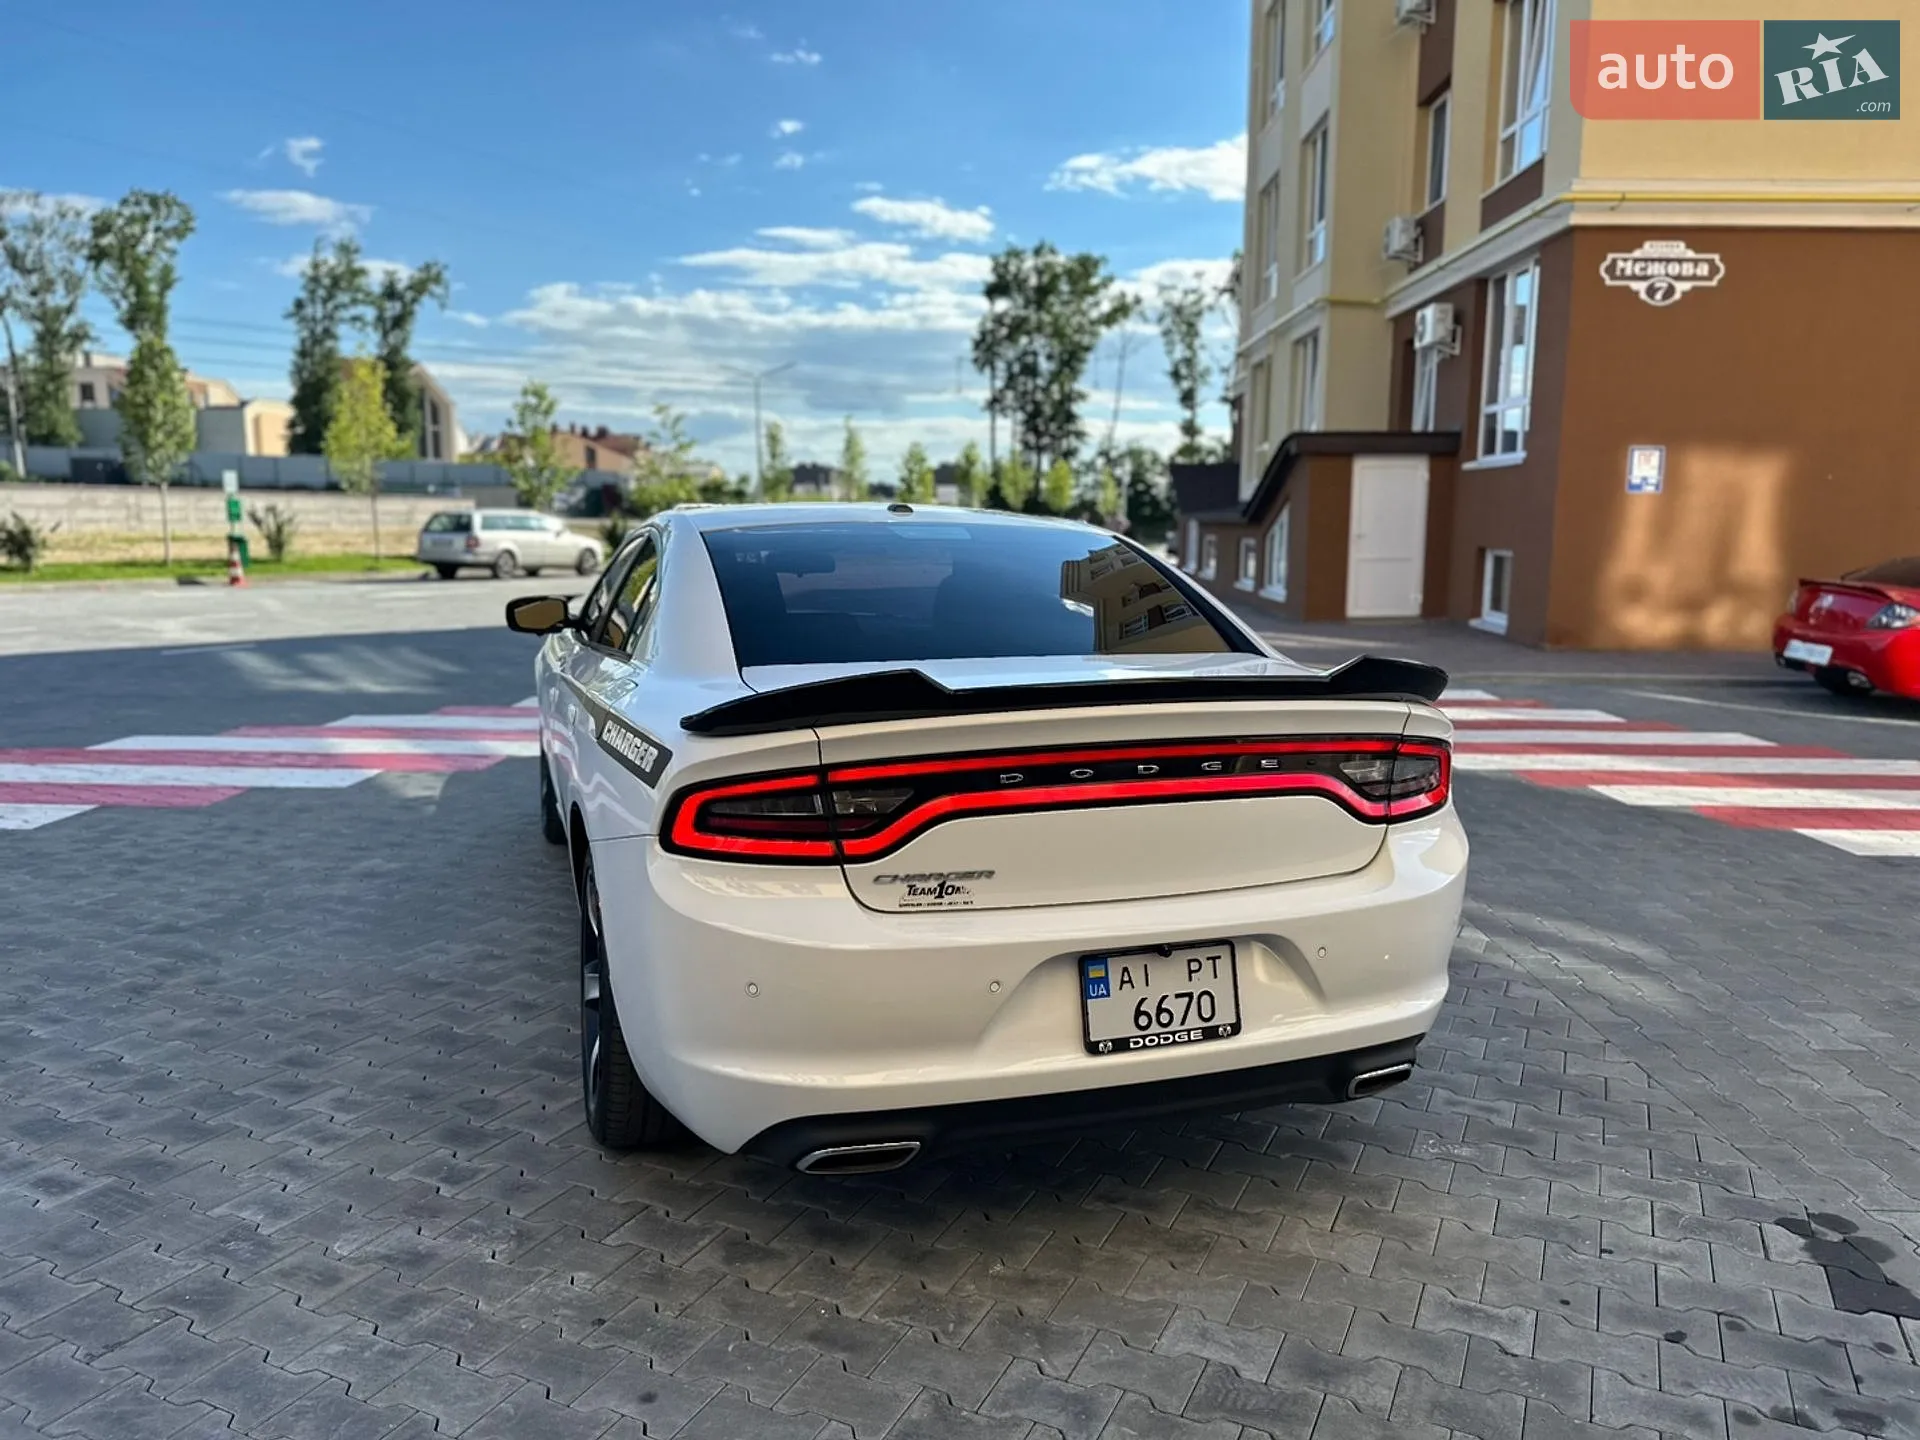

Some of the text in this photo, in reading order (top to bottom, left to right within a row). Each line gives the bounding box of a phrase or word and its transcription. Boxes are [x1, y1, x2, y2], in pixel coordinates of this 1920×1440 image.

[1653, 282, 1669, 301] 7
[602, 719, 659, 773] CHARGER
[1000, 758, 1279, 784] DODGE
[1118, 955, 1222, 991] AI PT
[1089, 983, 1108, 997] UA
[1133, 989, 1216, 1032] 6670
[1129, 1029, 1204, 1049] DODGE
